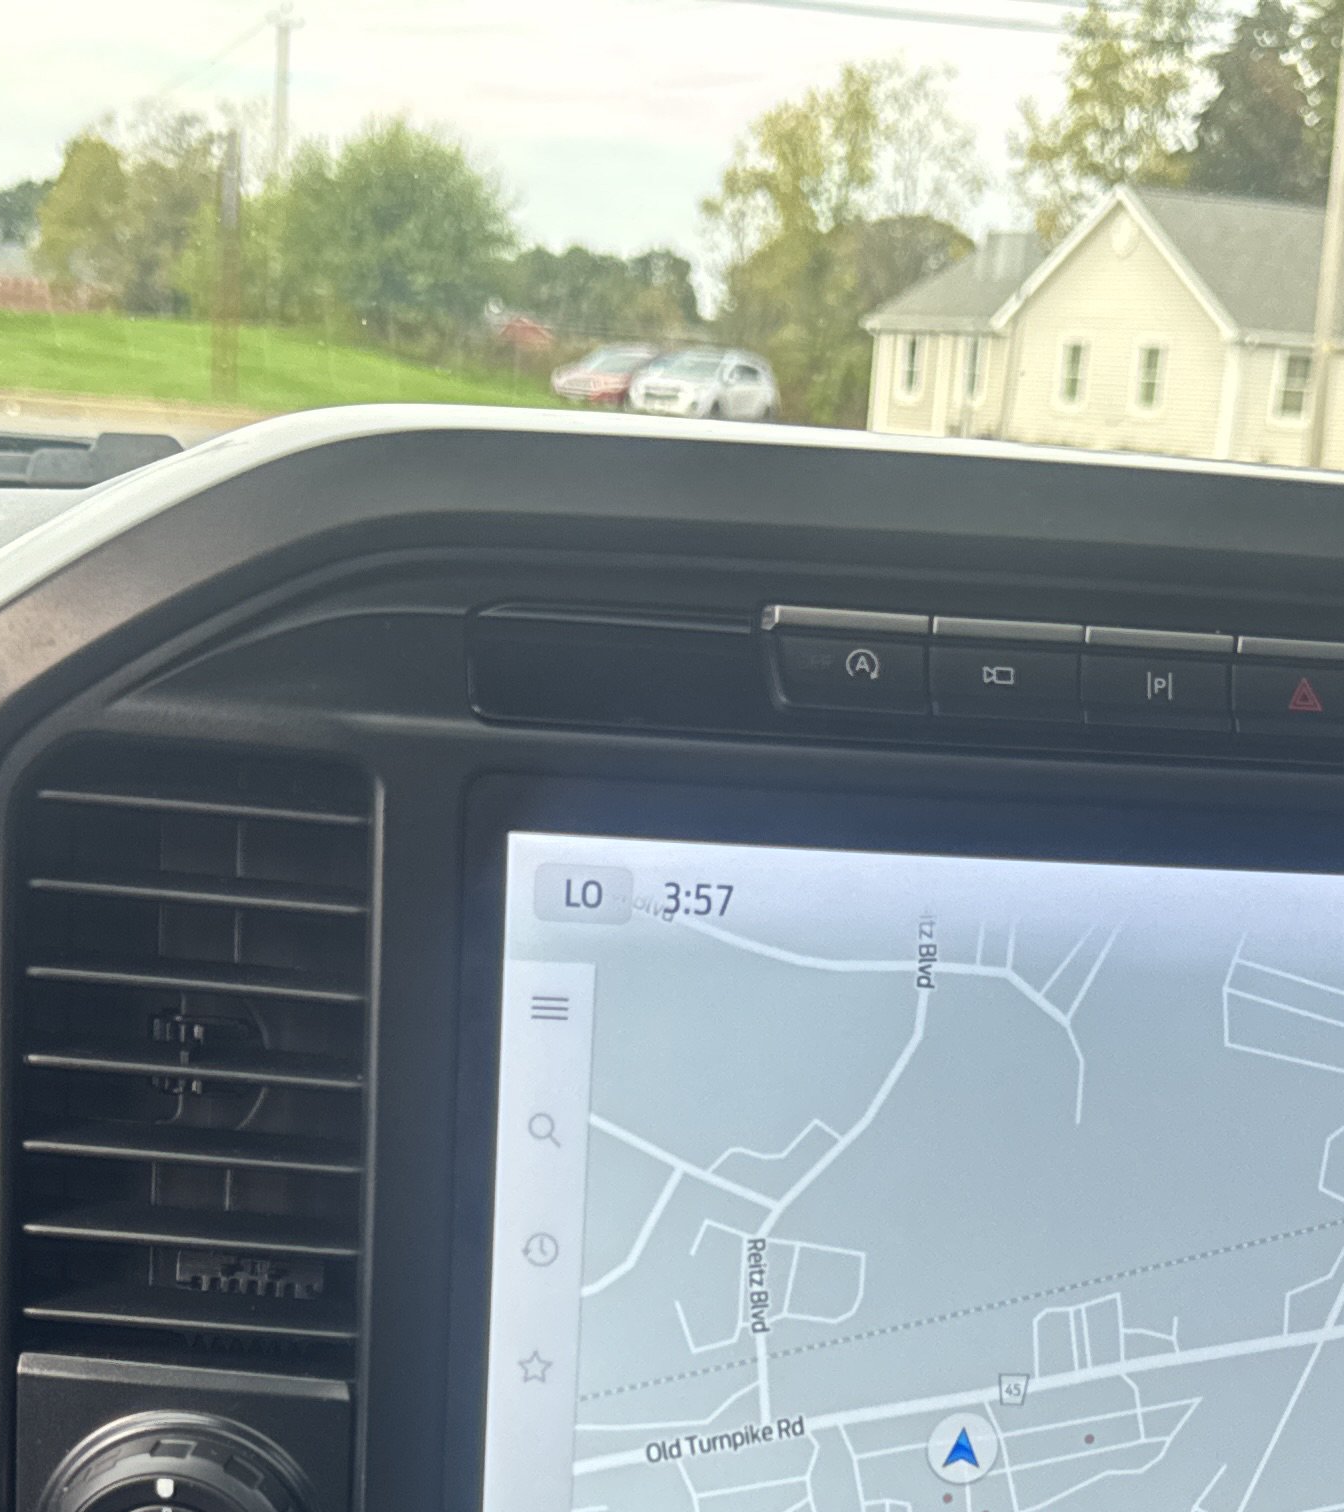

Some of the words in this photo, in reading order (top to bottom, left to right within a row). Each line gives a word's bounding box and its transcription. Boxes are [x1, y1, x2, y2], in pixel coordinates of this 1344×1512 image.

[564, 878, 602, 908] LO
[663, 881, 734, 917] 3:57
[916, 943, 937, 989] Blvd
[747, 1238, 768, 1285] Reitz
[749, 1288, 771, 1334] Blvd
[1004, 1382, 1022, 1398] 45
[645, 1440, 680, 1465] Old
[684, 1422, 775, 1457] Turnpike
[777, 1417, 805, 1441] Rd
